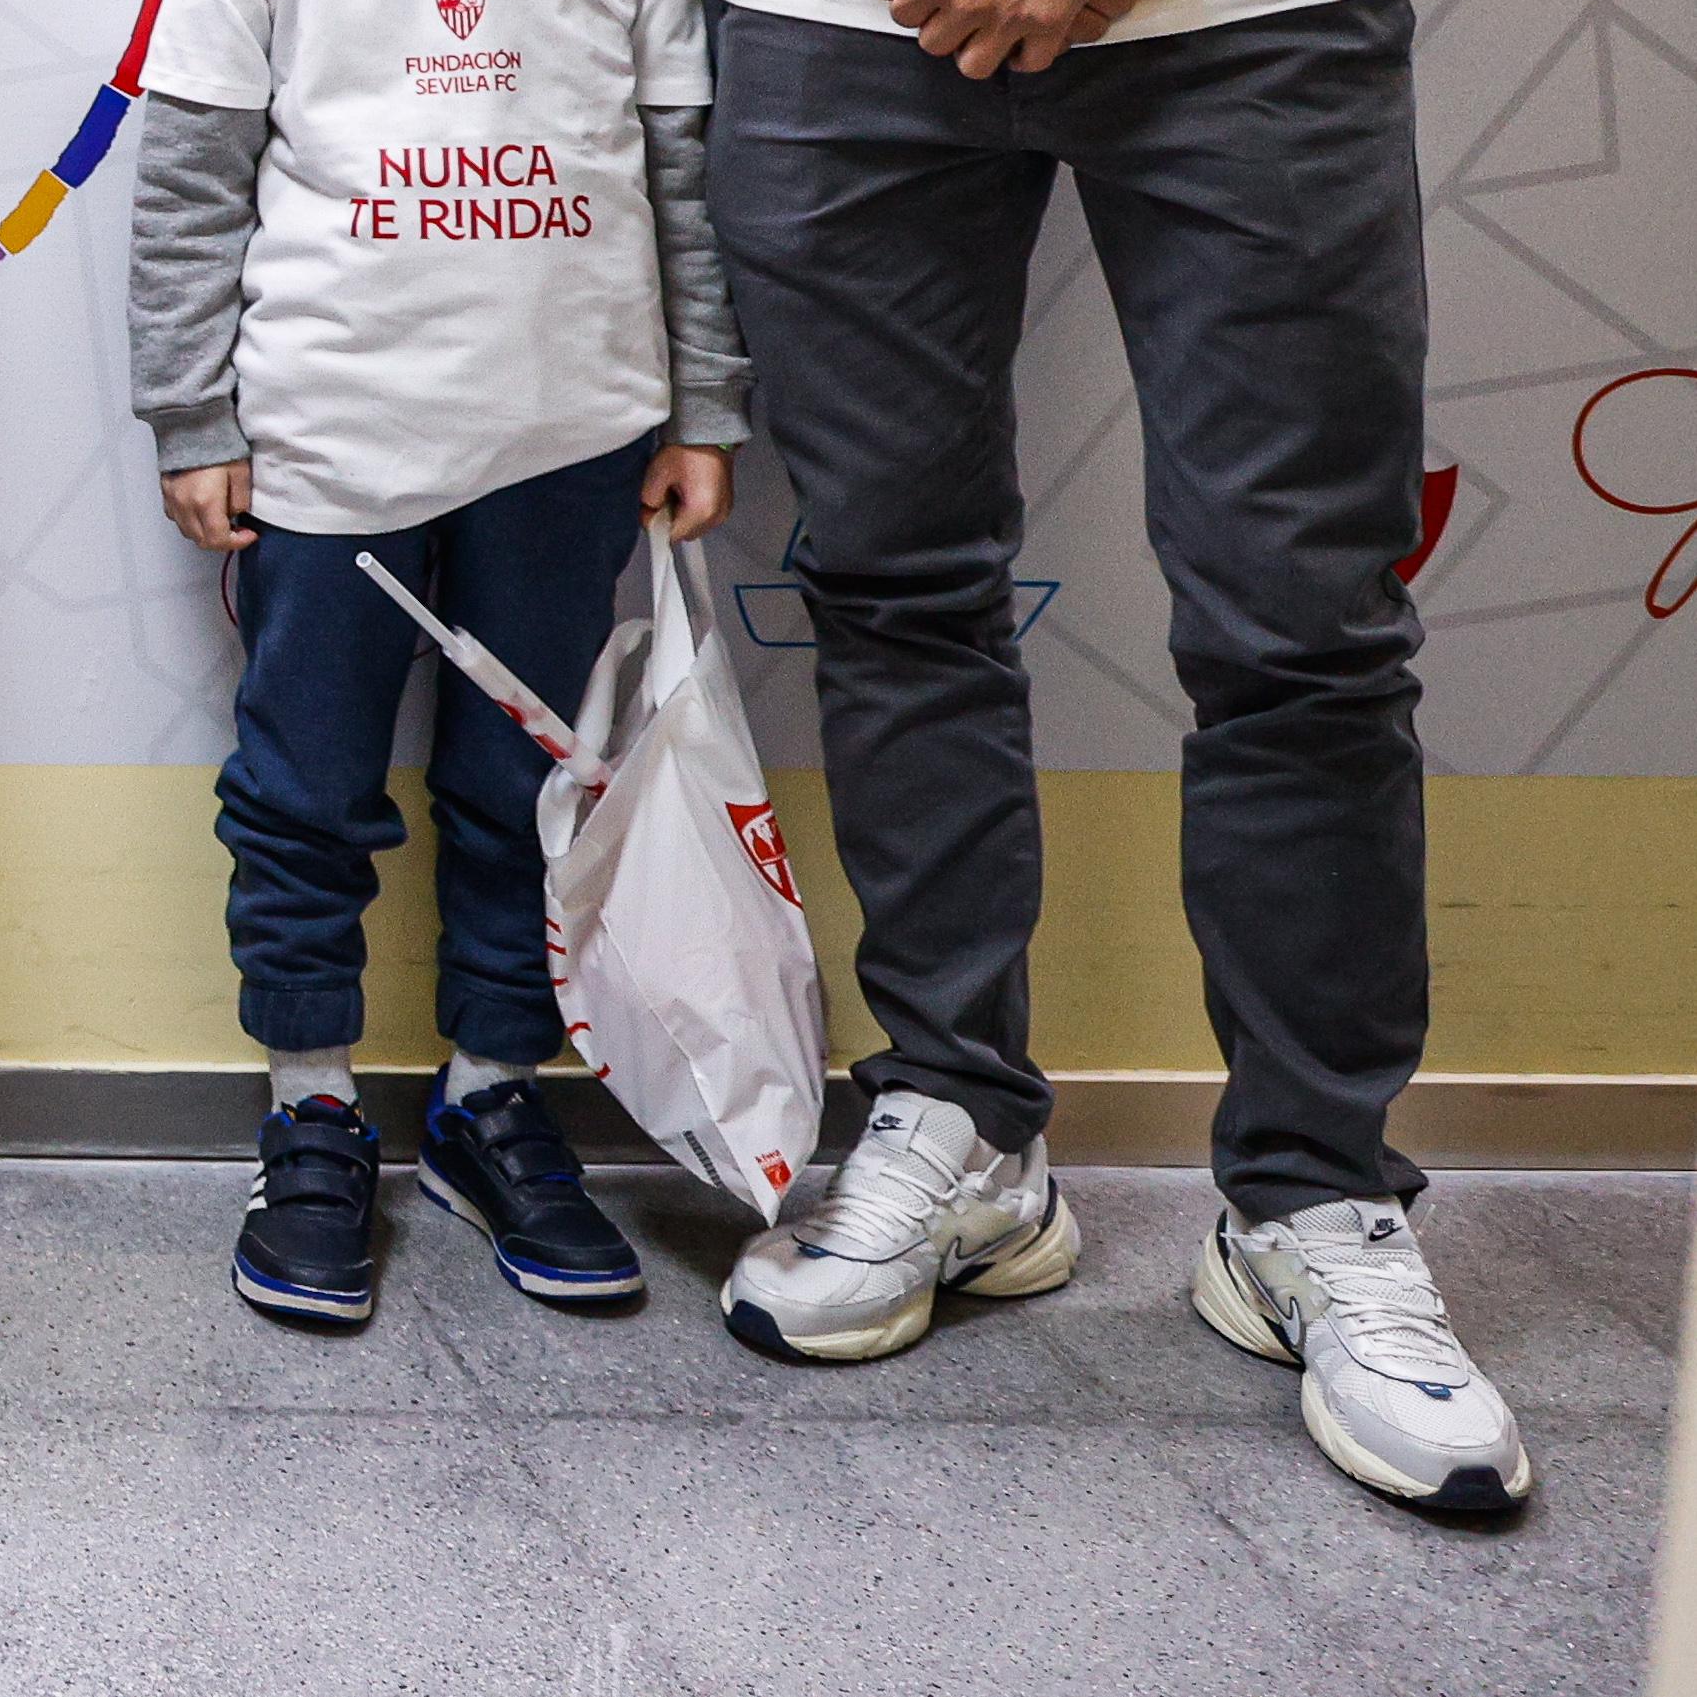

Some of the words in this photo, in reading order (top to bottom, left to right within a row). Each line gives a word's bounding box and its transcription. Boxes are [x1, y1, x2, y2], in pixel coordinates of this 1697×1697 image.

[405, 48, 522, 75] FUNDACIÓN
[415, 75, 490, 95] SEVILLA
[494, 73, 517, 92] FC
[379, 144, 557, 188] NUNCA
[349, 198, 399, 239] TE
[419, 195, 593, 241] RINDAS
